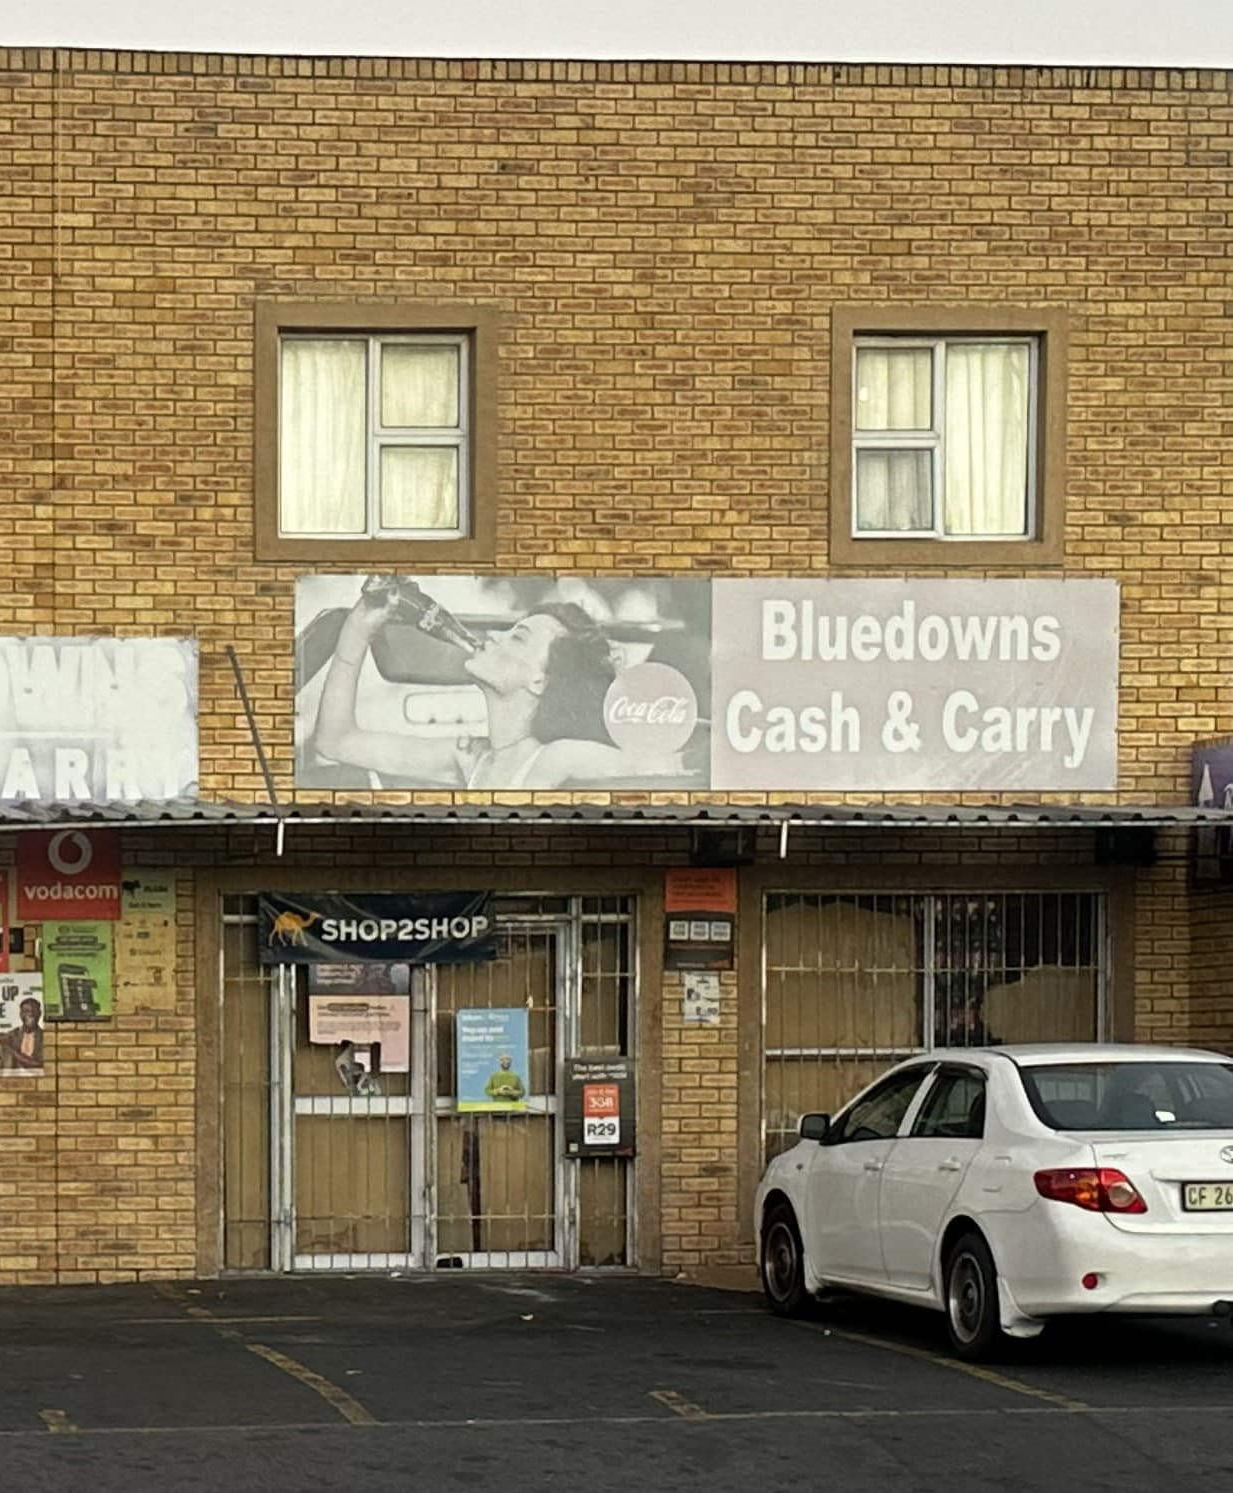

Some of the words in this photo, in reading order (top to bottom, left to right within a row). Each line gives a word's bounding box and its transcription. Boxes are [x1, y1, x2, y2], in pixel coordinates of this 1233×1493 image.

[761, 599, 1062, 662] Bluedowns
[726, 690, 861, 753] Cash
[881, 691, 922, 753] &
[943, 690, 1095, 769] Carry
[24, 882, 119, 900] vodacom
[321, 916, 489, 941] SHOP2SHOP
[2, 986, 19, 1001] UP
[587, 1123, 616, 1136] R29
[1188, 1187, 1206, 1206] CF
